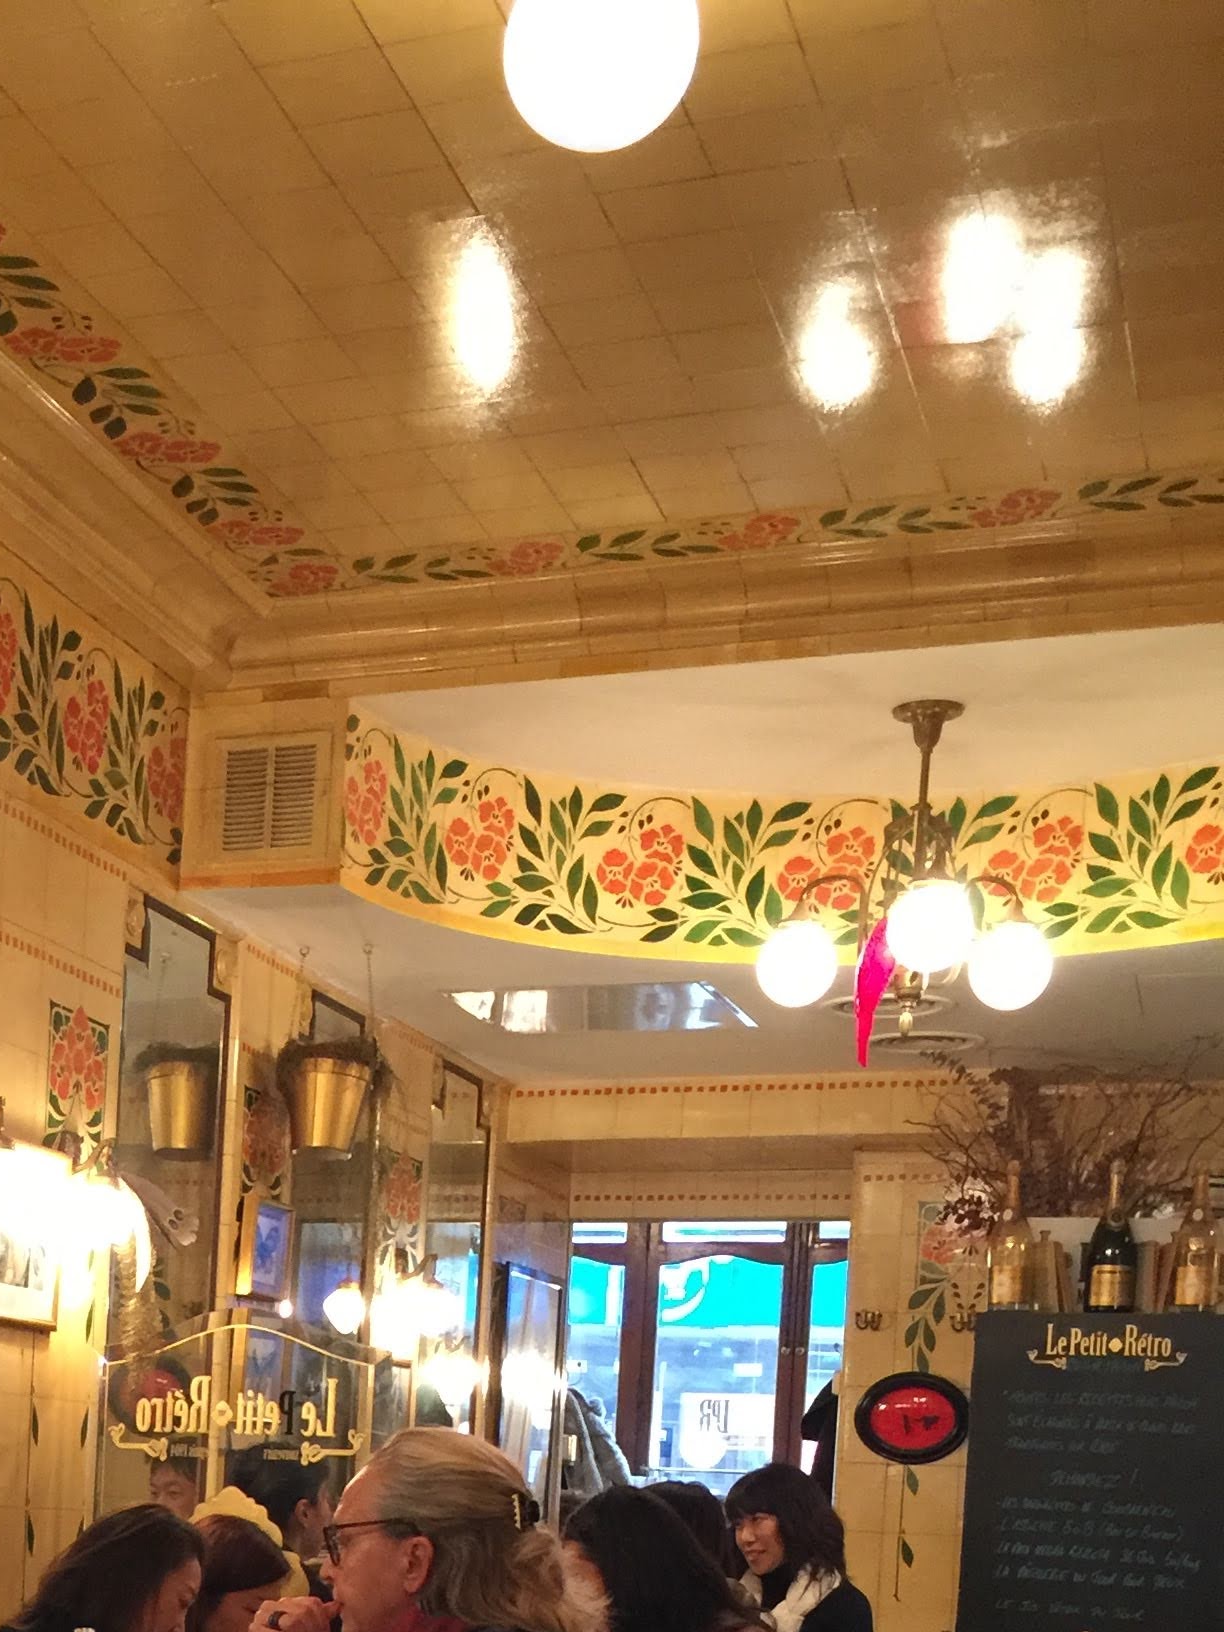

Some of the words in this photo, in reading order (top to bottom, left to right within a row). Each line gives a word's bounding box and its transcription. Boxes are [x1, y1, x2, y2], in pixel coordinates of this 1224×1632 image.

[1045, 1323, 1067, 1355] Le
[1069, 1327, 1108, 1356] Petit
[1124, 1324, 1172, 1358] Rétro
